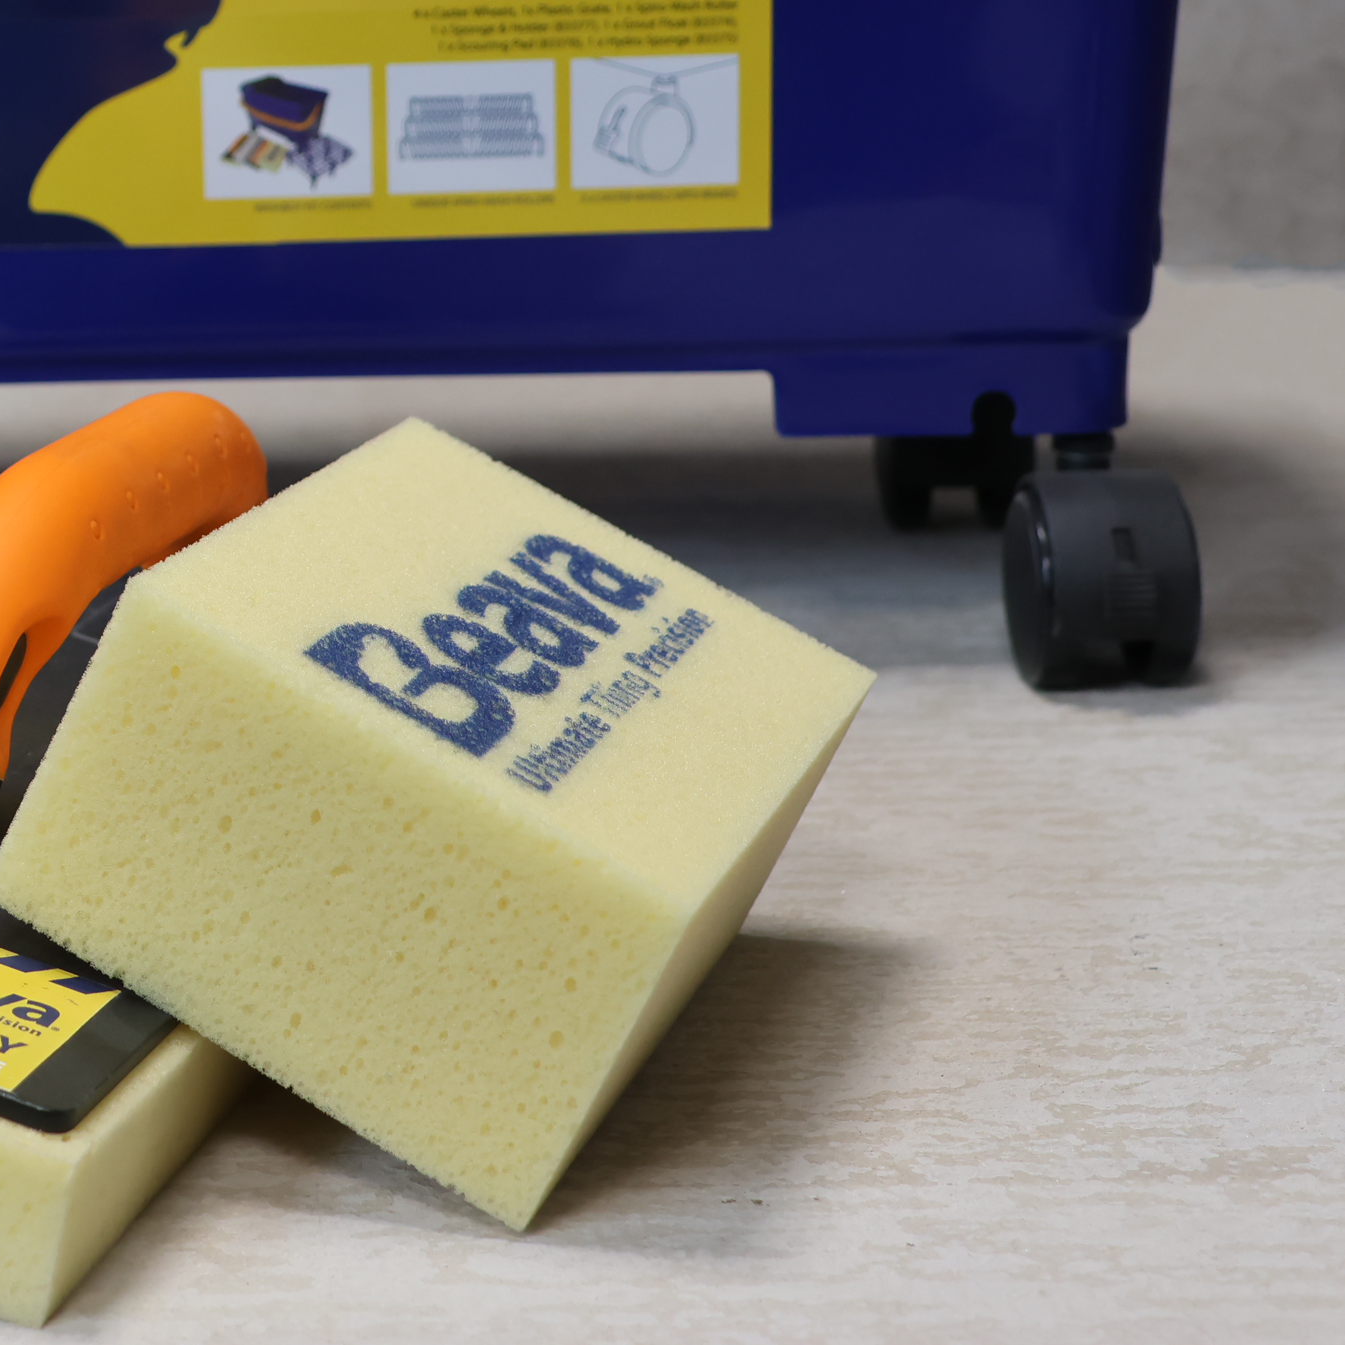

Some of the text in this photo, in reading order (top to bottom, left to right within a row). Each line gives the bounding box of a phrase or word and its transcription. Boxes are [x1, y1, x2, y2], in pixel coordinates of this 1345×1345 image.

[303, 534, 657, 757] Beava
[505, 608, 716, 792] Ultimate Tiling Precision
